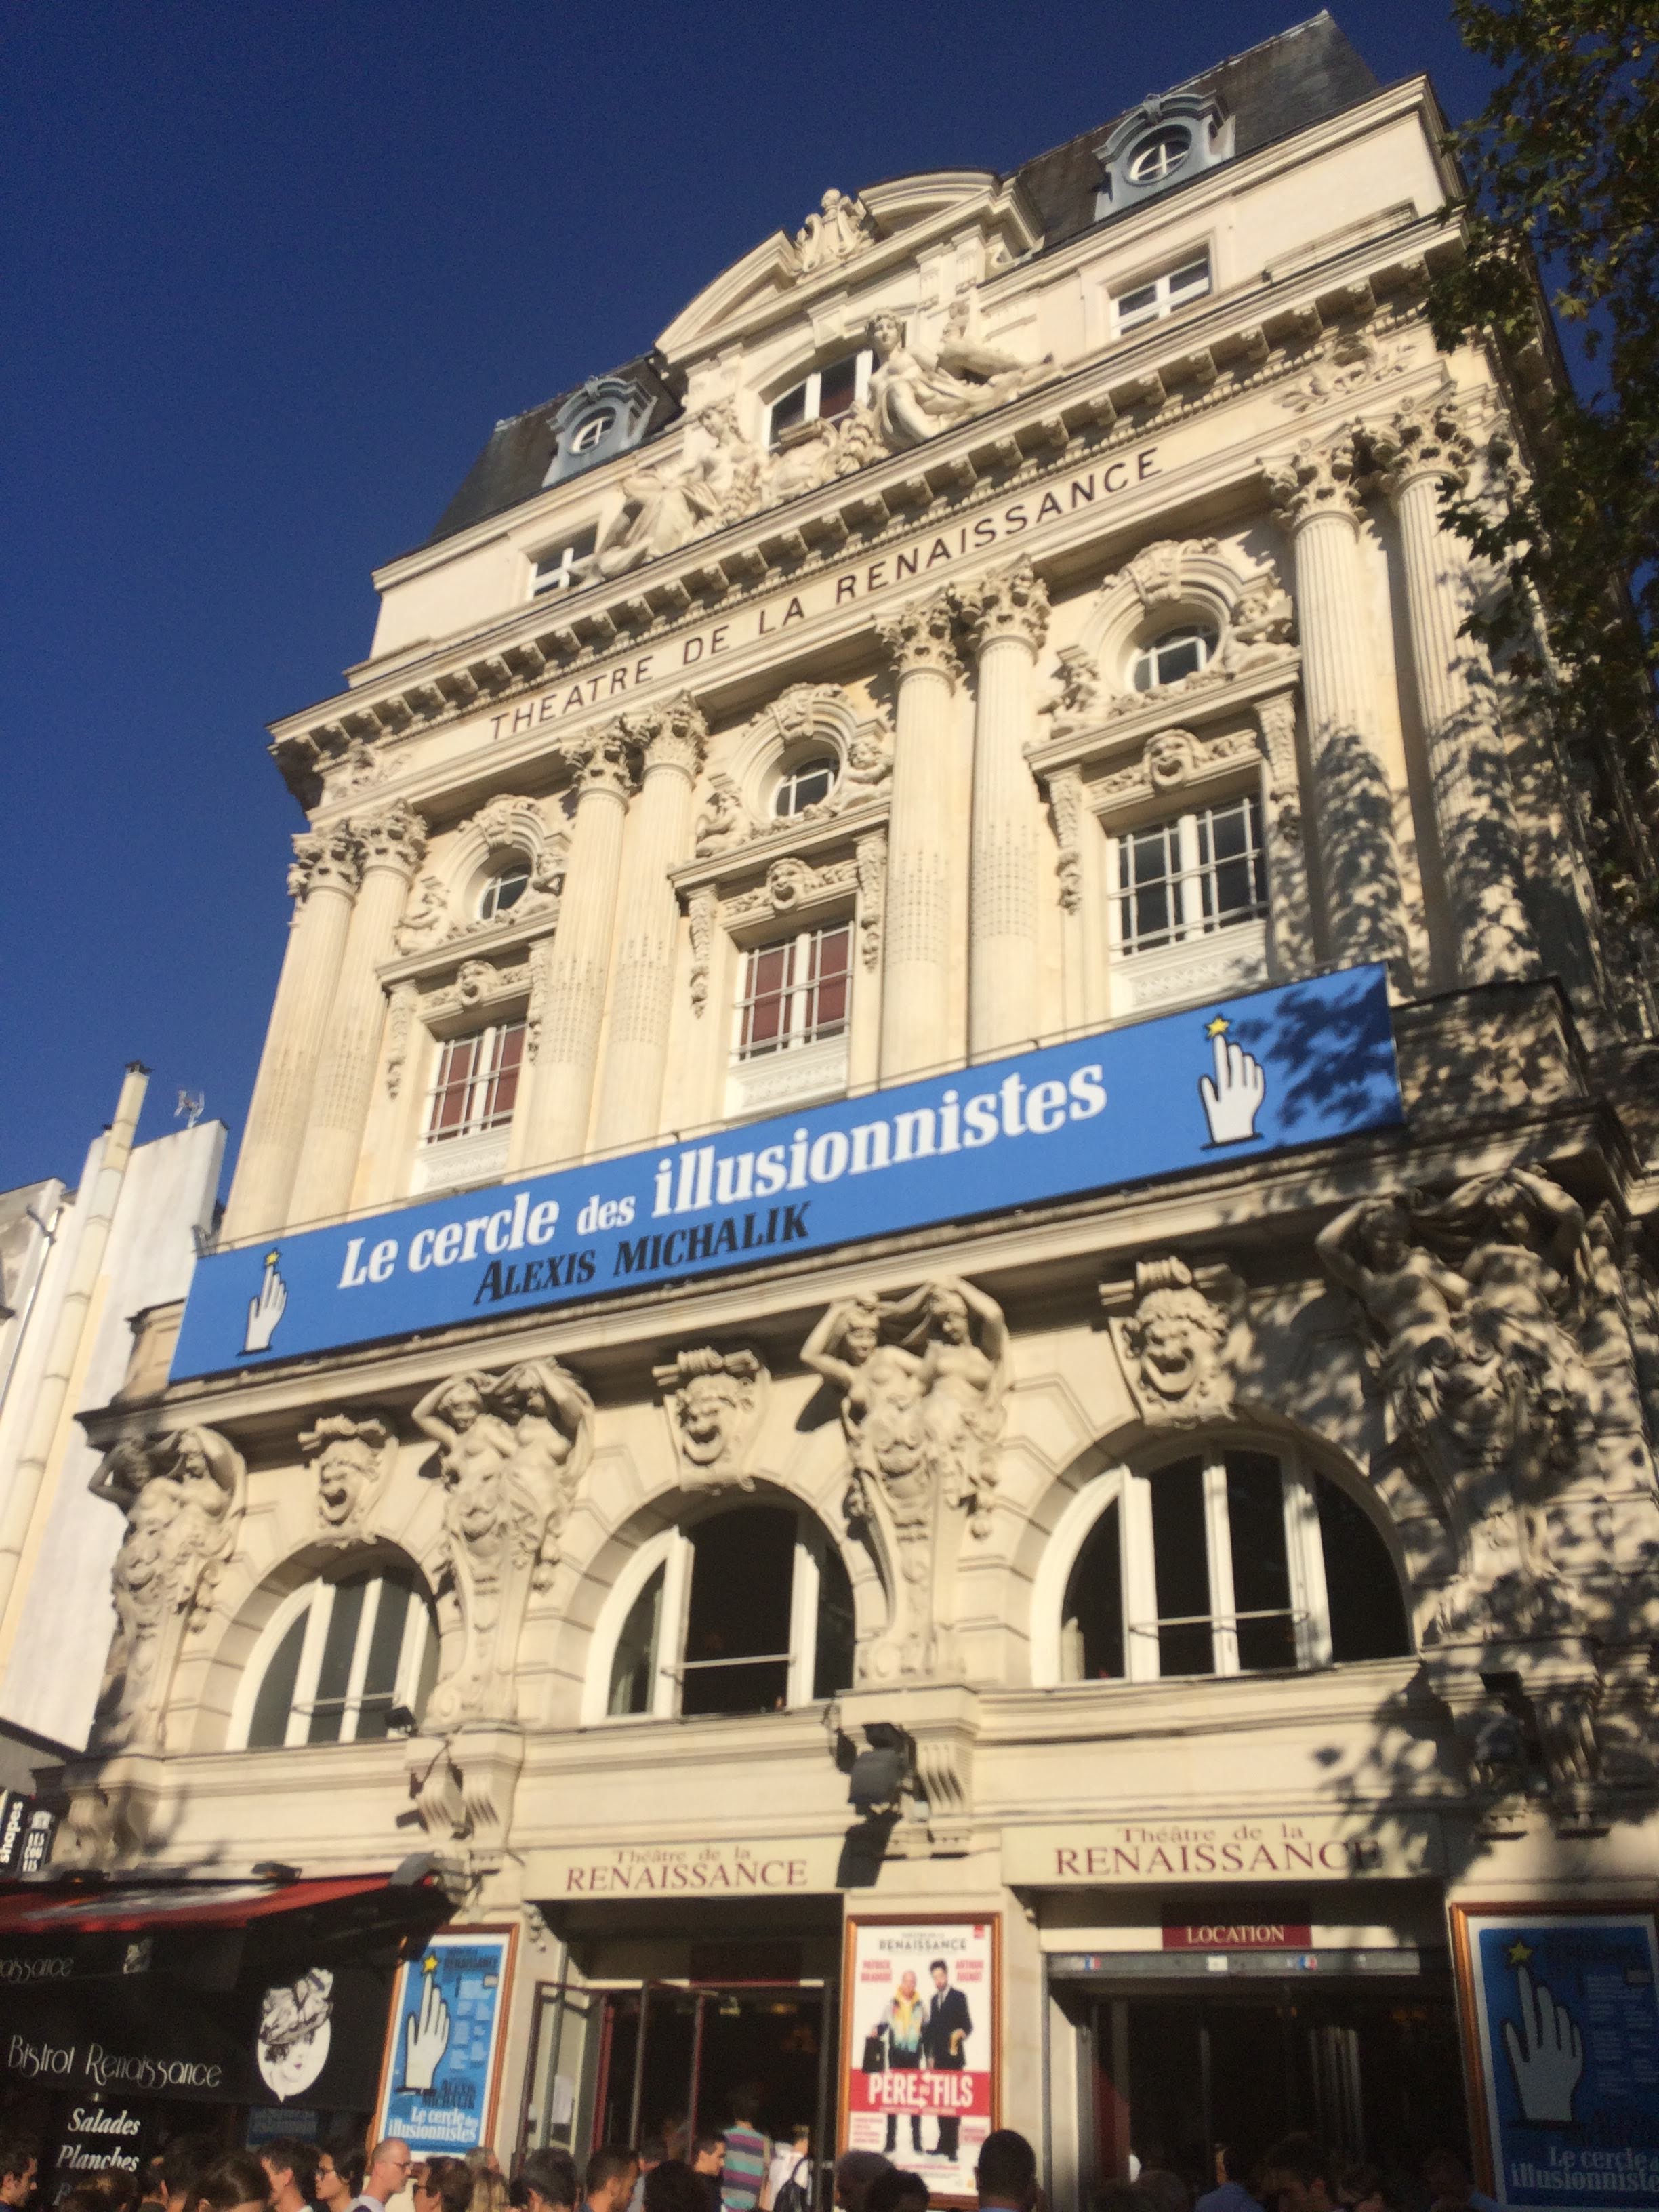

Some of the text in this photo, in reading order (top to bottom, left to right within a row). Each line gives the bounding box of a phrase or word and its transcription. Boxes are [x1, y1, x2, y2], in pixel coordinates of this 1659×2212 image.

[490, 447, 1164, 740] THEATRE DE LA RENAISSANCE
[337, 1063, 1107, 1289] Le cercle des illusionnistes
[473, 1201, 812, 1306] ALEXIS MICHALIK
[0, 1801, 23, 1864] shapes
[1122, 1823, 1305, 1844] Théâtre de la
[616, 1846, 750, 1864] Théâtre de la
[1055, 1841, 1380, 1875] RENAISSANCE
[566, 1860, 808, 1892] RENAISSANCE
[1187, 1925, 1285, 1944] LOCATION
[85, 2043, 222, 2089] Renaissance
[930, 2074, 974, 2108] FILS
[68, 2107, 141, 2135] Salades
[56, 2144, 140, 2171] Planches
[1580, 2147, 1647, 2170] cercle
